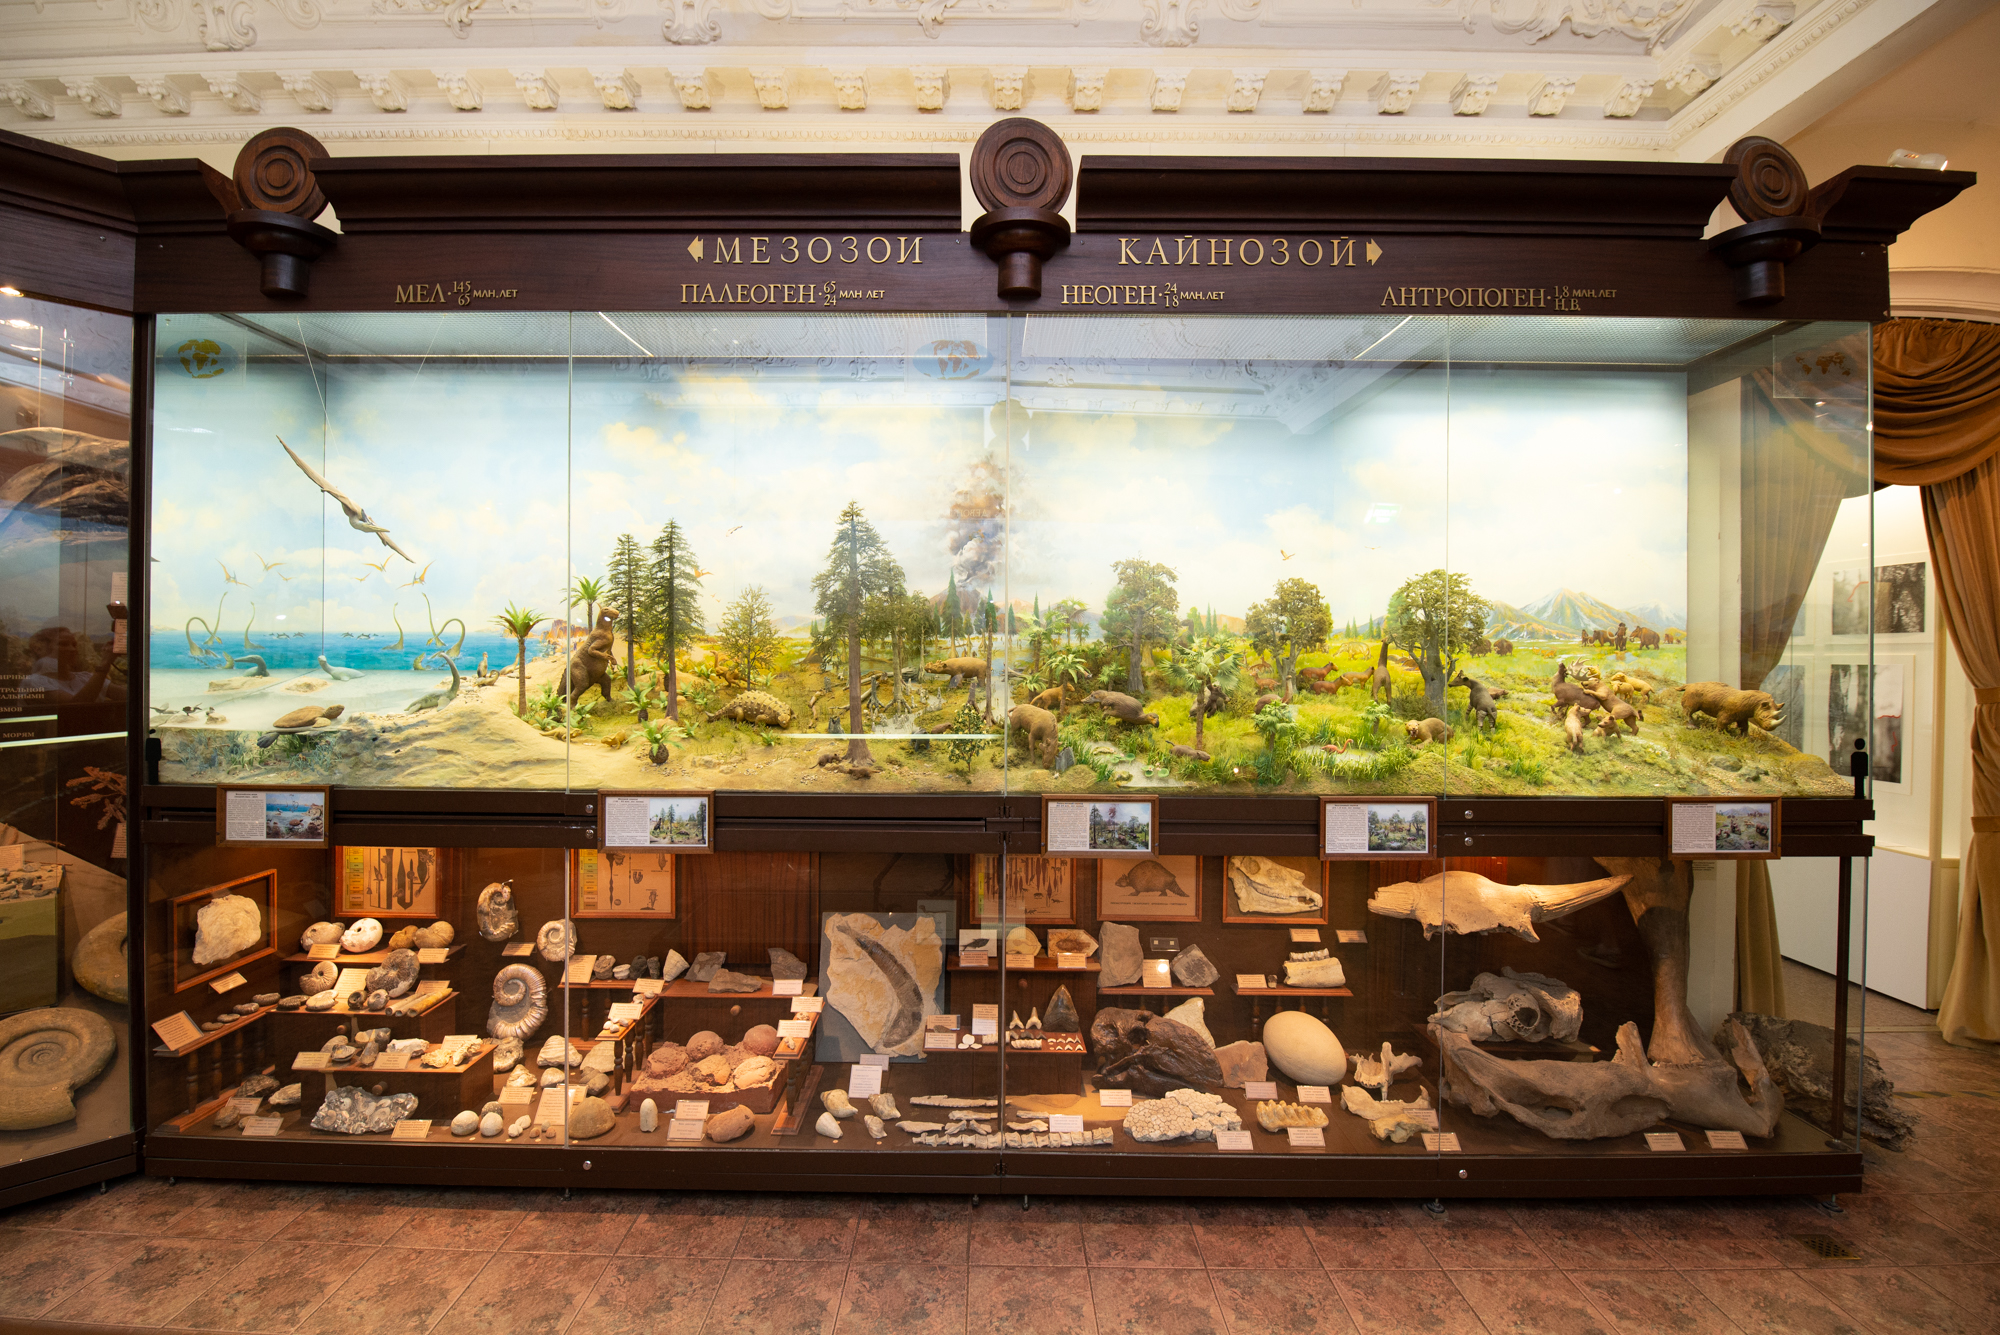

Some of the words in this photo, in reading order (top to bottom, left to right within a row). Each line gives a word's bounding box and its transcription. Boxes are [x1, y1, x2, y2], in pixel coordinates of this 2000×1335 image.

[713, 236, 923, 264] МЕЗОЗОИ
[1118, 235, 1356, 266] КАЙНОЗОЙ
[453, 281, 471, 293] 145
[823, 281, 836, 294] 65
[866, 289, 885, 299] ЛЕТ
[1164, 282, 1178, 294] 24
[458, 293, 471, 306] 65
[823, 294, 837, 306] 24
